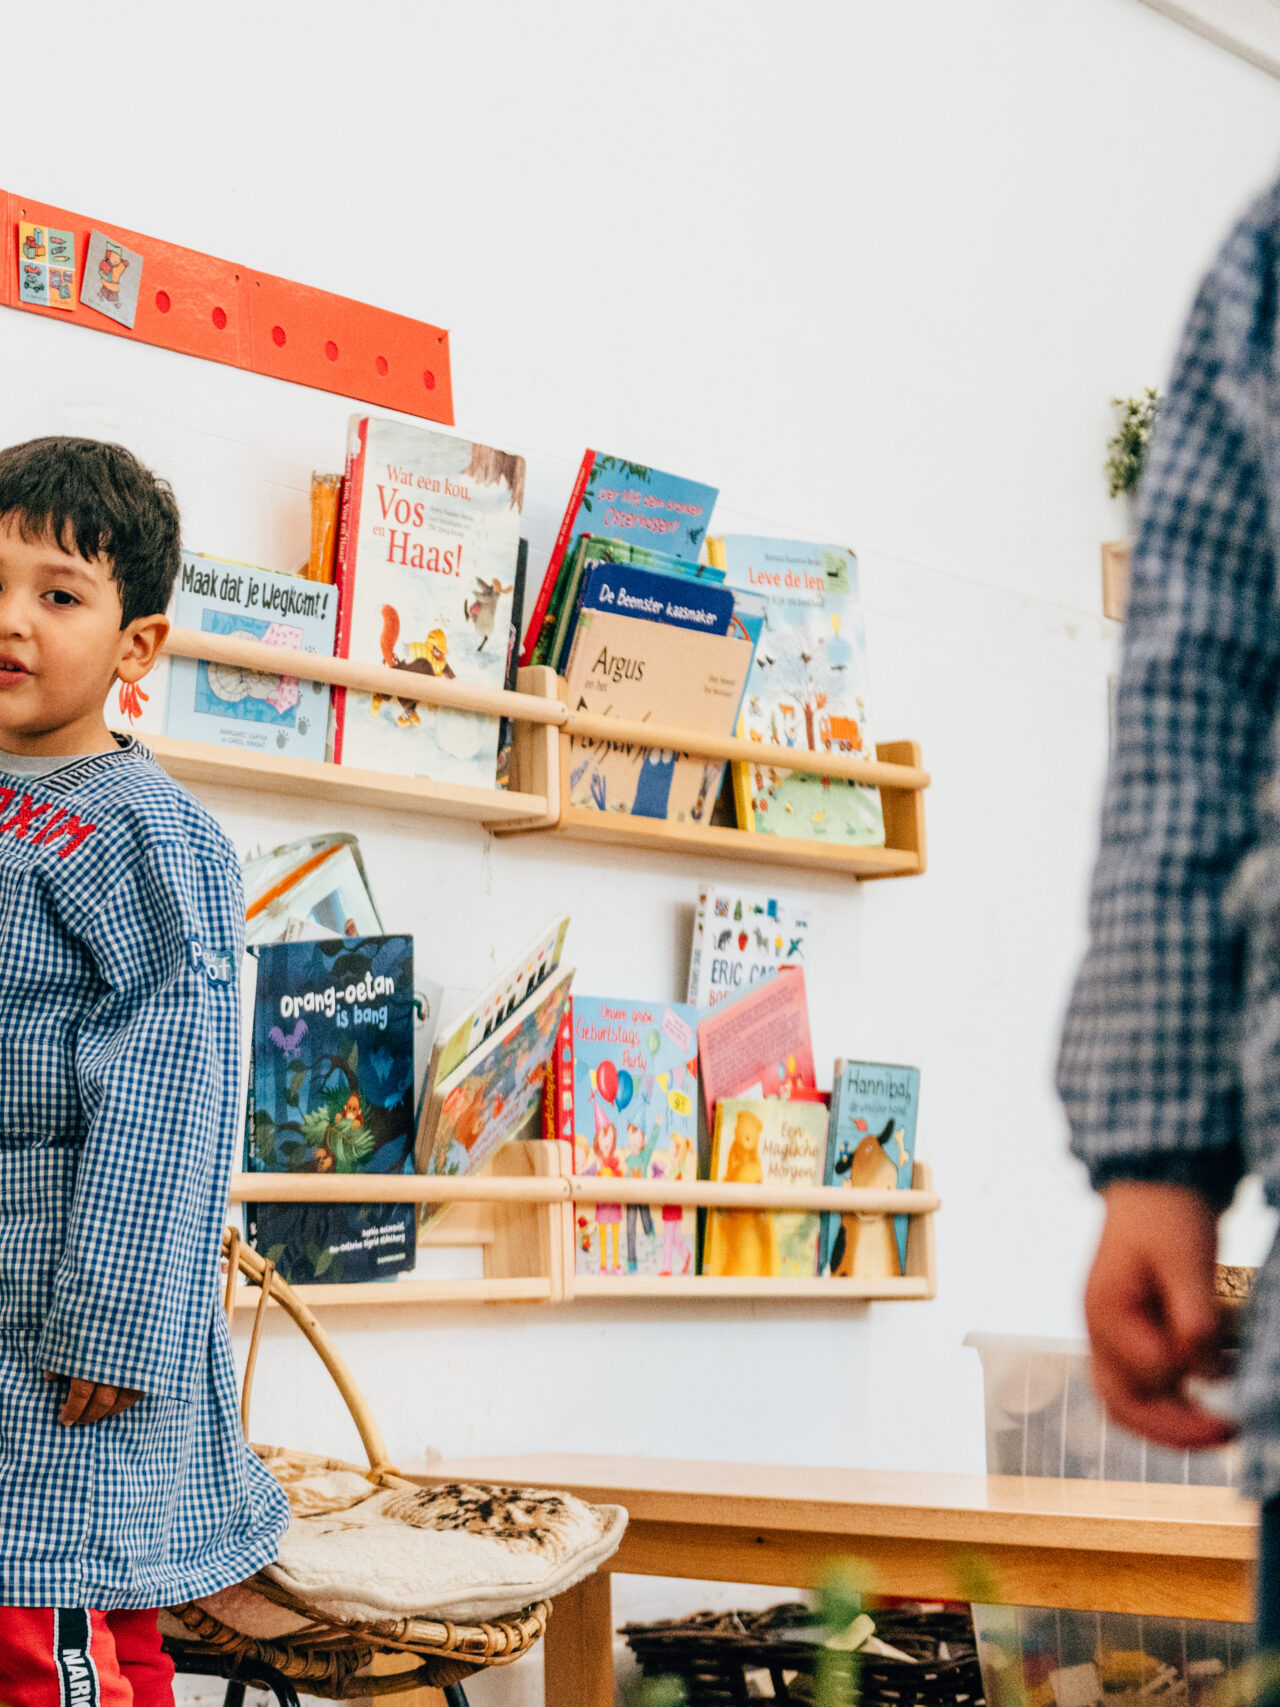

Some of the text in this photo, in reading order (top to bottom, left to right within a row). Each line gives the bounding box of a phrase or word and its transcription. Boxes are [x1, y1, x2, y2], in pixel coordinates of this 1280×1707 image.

[387, 464, 472, 502] Wat een kou,
[376, 484, 425, 528] Vos
[372, 525, 385, 537] en
[386, 528, 463, 577] Haas!
[181, 562, 218, 597] Maak
[220, 572, 243, 603] dat
[244, 577, 260, 608] je
[748, 565, 825, 592] Leve de len
[599, 583, 615, 604] De
[617, 587, 664, 614] Beemster
[665, 602, 718, 626] kaasmaker
[592, 645, 646, 683] Argus
[584, 680, 594, 689] en
[711, 958, 743, 987] ERIC
[336, 1003, 388, 1031] is bang
[600, 1002, 627, 1021] Unsere
[576, 1015, 640, 1049] Geburtstags
[622, 1048, 648, 1075] Party
